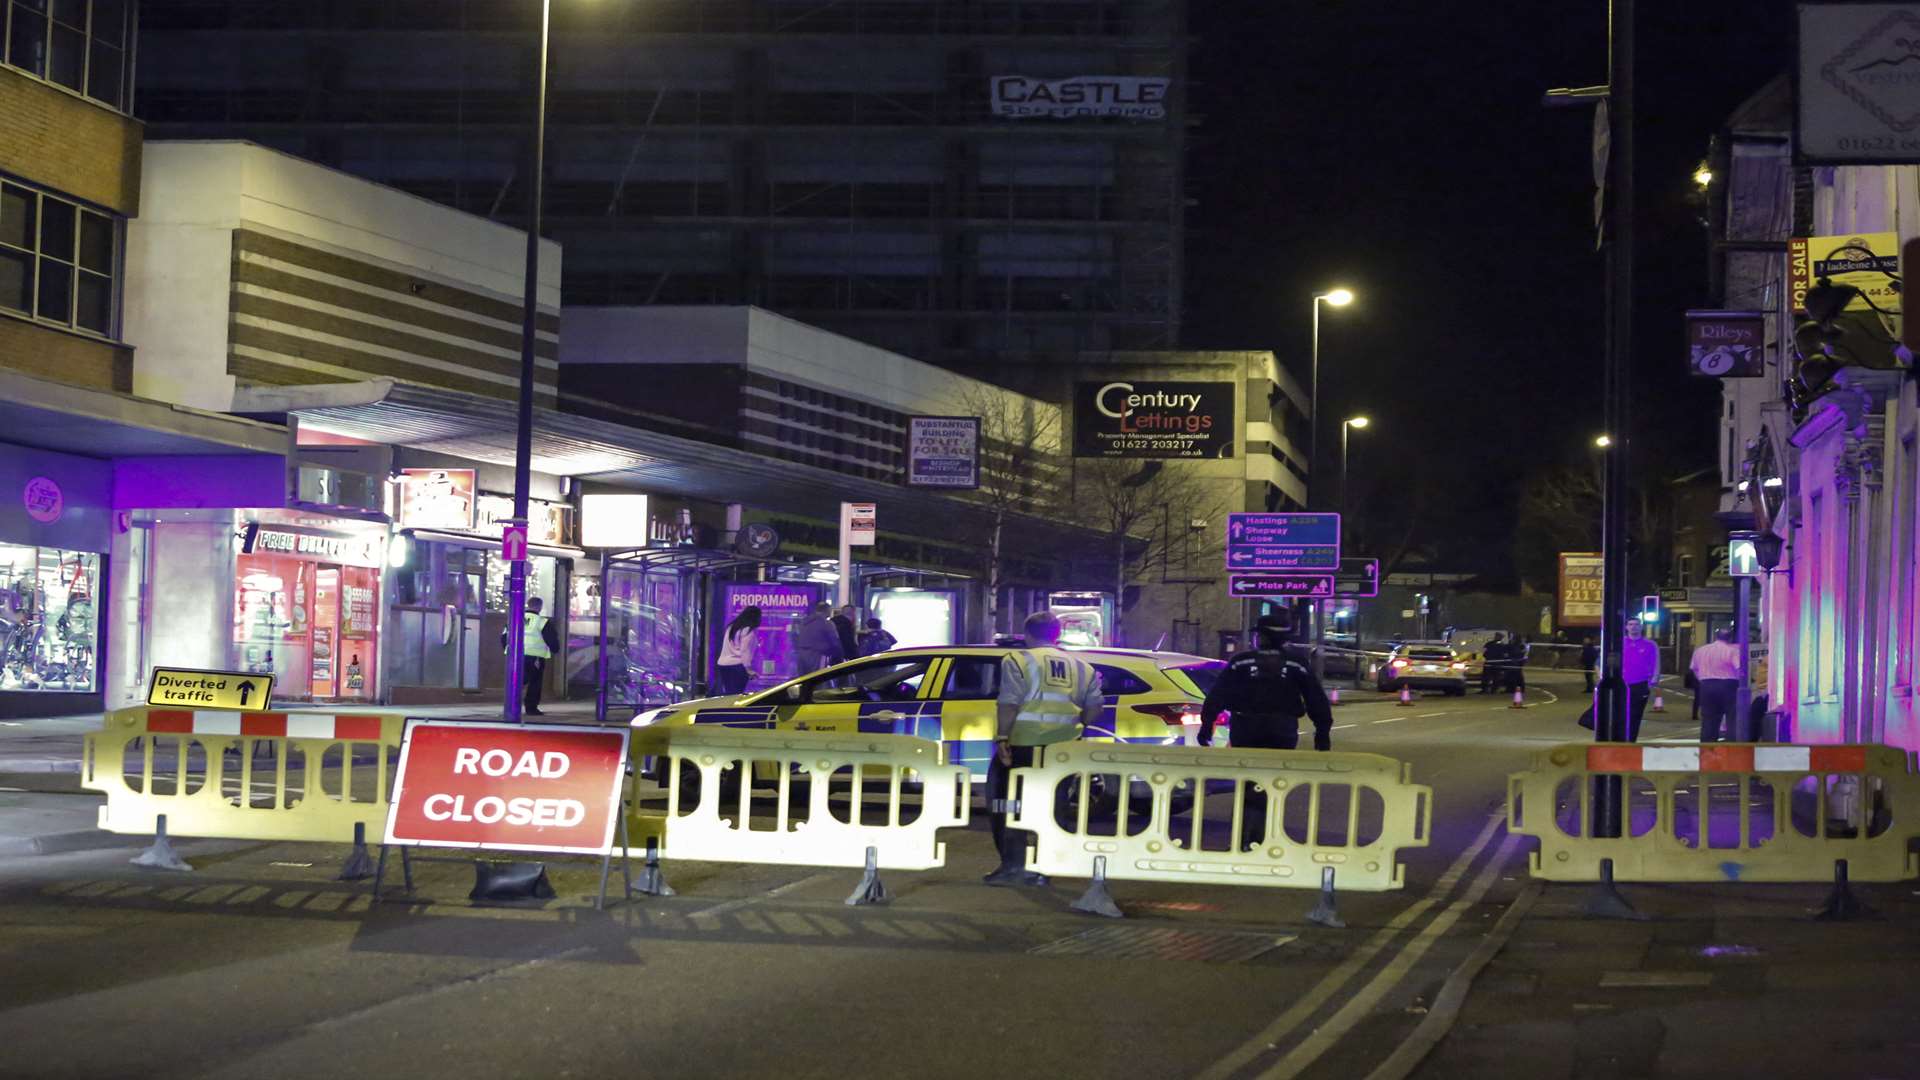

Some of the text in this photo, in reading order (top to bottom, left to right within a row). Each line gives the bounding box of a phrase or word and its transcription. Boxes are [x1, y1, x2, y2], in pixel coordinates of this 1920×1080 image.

[998, 78, 1164, 104] CASTLE
[1792, 242, 1807, 310] FOR SALE
[1096, 382, 1202, 418] Century
[1120, 400, 1212, 432] Lettings
[1113, 441, 1194, 449] 01622 203217
[1246, 517, 1287, 525] Hastings
[259, 530, 296, 551] FREE
[1245, 527, 1288, 535] Shepway
[1286, 582, 1308, 590] Park
[732, 594, 809, 607] PROPAMANDA
[1050, 660, 1066, 679] M
[158, 676, 227, 690] Diverted
[164, 690, 214, 702] traffic
[453, 747, 571, 779] ROAD
[423, 793, 586, 828] CLOSED
